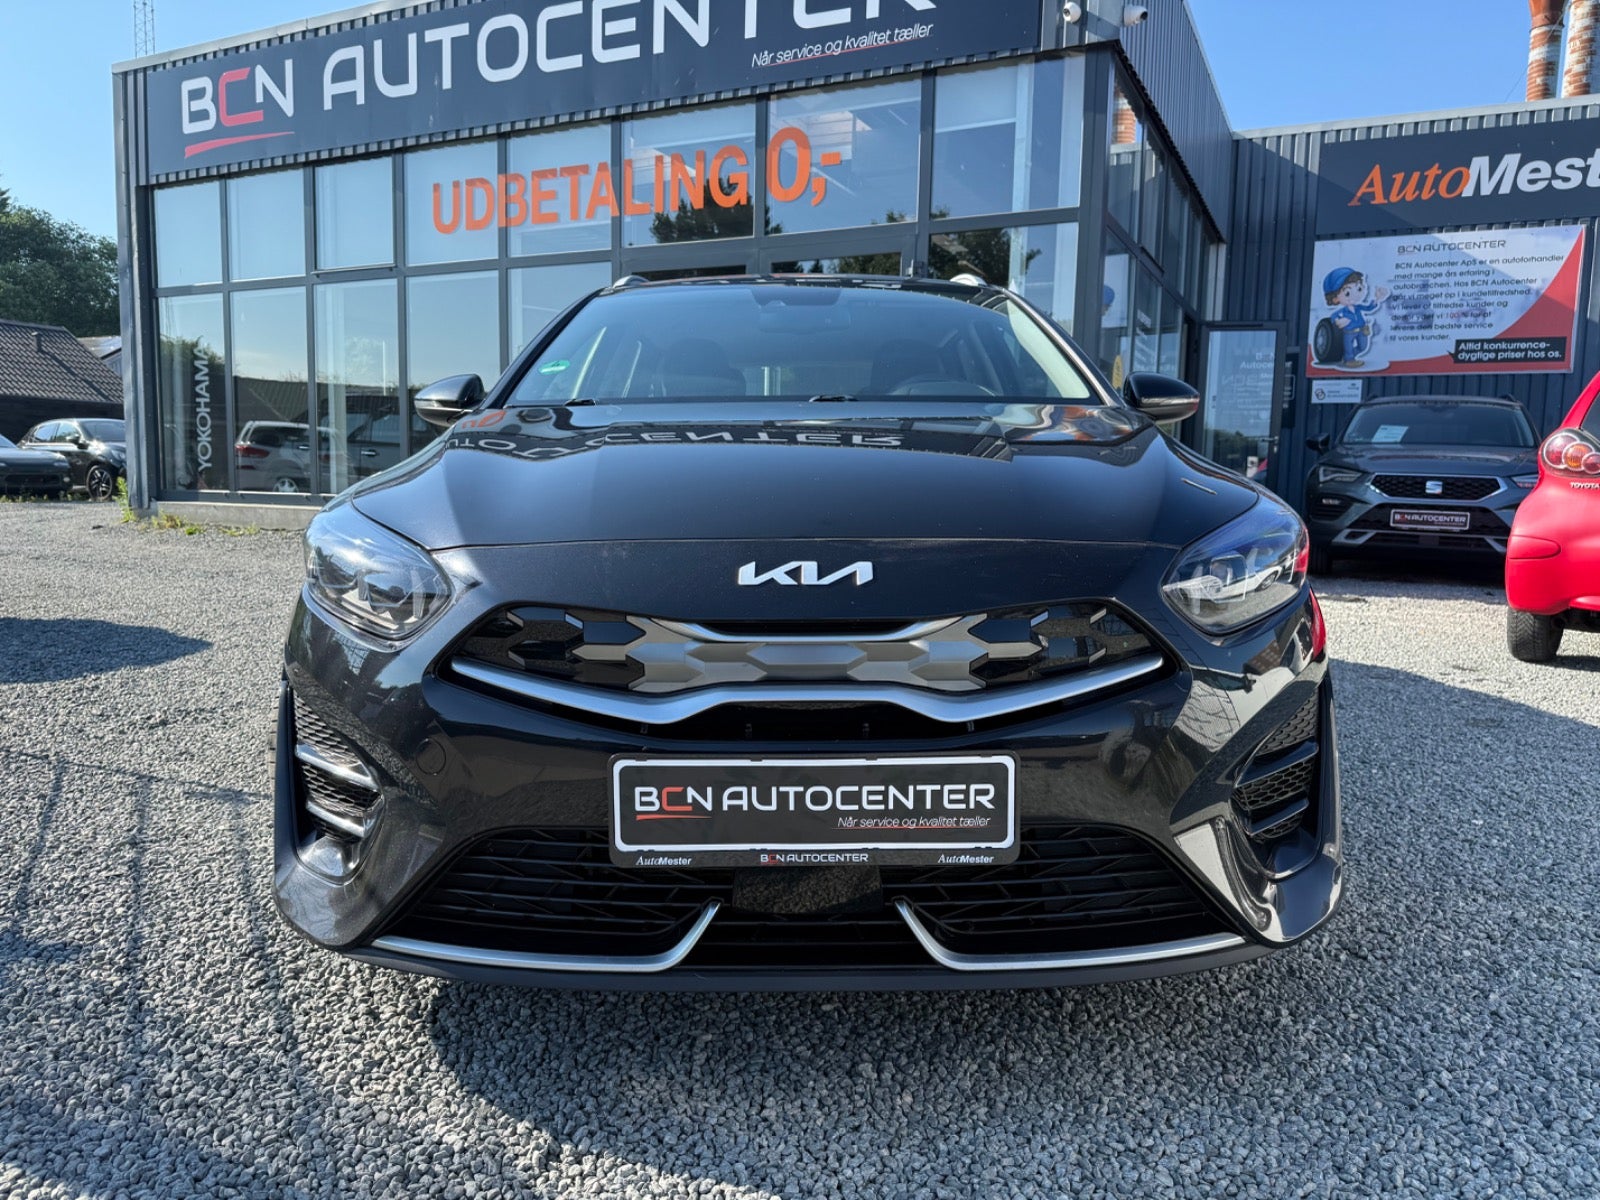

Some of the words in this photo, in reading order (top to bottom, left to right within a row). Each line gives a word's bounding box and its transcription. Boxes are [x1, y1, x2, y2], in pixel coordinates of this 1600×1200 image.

[751, 50, 775, 68] Når
[776, 43, 823, 65] service
[824, 39, 843, 56] og
[845, 28, 891, 49] kvalitet
[893, 23, 935, 43] tæller
[181, 59, 294, 135] BCN
[432, 144, 750, 235] UDBETALING
[1397, 244, 1422, 254] BCN
[1423, 239, 1507, 252] AUTOCENTER
[1395, 262, 1412, 270] BCN
[1414, 259, 1459, 269] Autocenter
[1460, 259, 1477, 268] ApS
[1502, 254, 1564, 264] autoforhandler
[1394, 272, 1413, 280] med
[1414, 271, 1443, 280] mange
[1459, 268, 1491, 278] erfaring
[1454, 280, 1469, 288] Hos
[1471, 279, 1488, 287] BCN
[1490, 277, 1537, 286] Autocenter
[1416, 291, 1443, 301] meget
[1444, 291, 1455, 299] op
[1433, 300, 1464, 310] tilfredse
[1466, 299, 1494, 309] kunder
[1496, 300, 1508, 308] og
[1434, 322, 1462, 331] bedste
[1463, 321, 1493, 329] service
[1398, 334, 1419, 342] vores
[1458, 342, 1481, 351] Altid
[1483, 341, 1550, 351] konkurrence-
[1458, 351, 1496, 362] dygtige
[1497, 350, 1525, 360] priser
[1527, 349, 1545, 359] hos
[1547, 349, 1562, 359] os.
[193, 335, 213, 472] YOKOHAMA
[1569, 481, 1600, 489] TOYOTA
[1411, 514, 1467, 523] AUTOCENTER
[634, 786, 713, 812] BCN
[722, 783, 996, 812] AUTOCENTER
[837, 816, 858, 828] Når
[859, 816, 900, 828] service
[901, 818, 918, 830] og
[918, 815, 958, 828] kvalitet
[959, 815, 991, 828] tæller
[636, 855, 693, 866] AutoMester
[760, 853, 785, 863] BCN
[786, 853, 869, 863] AUTOCENTER
[938, 853, 994, 865] AutoMester
